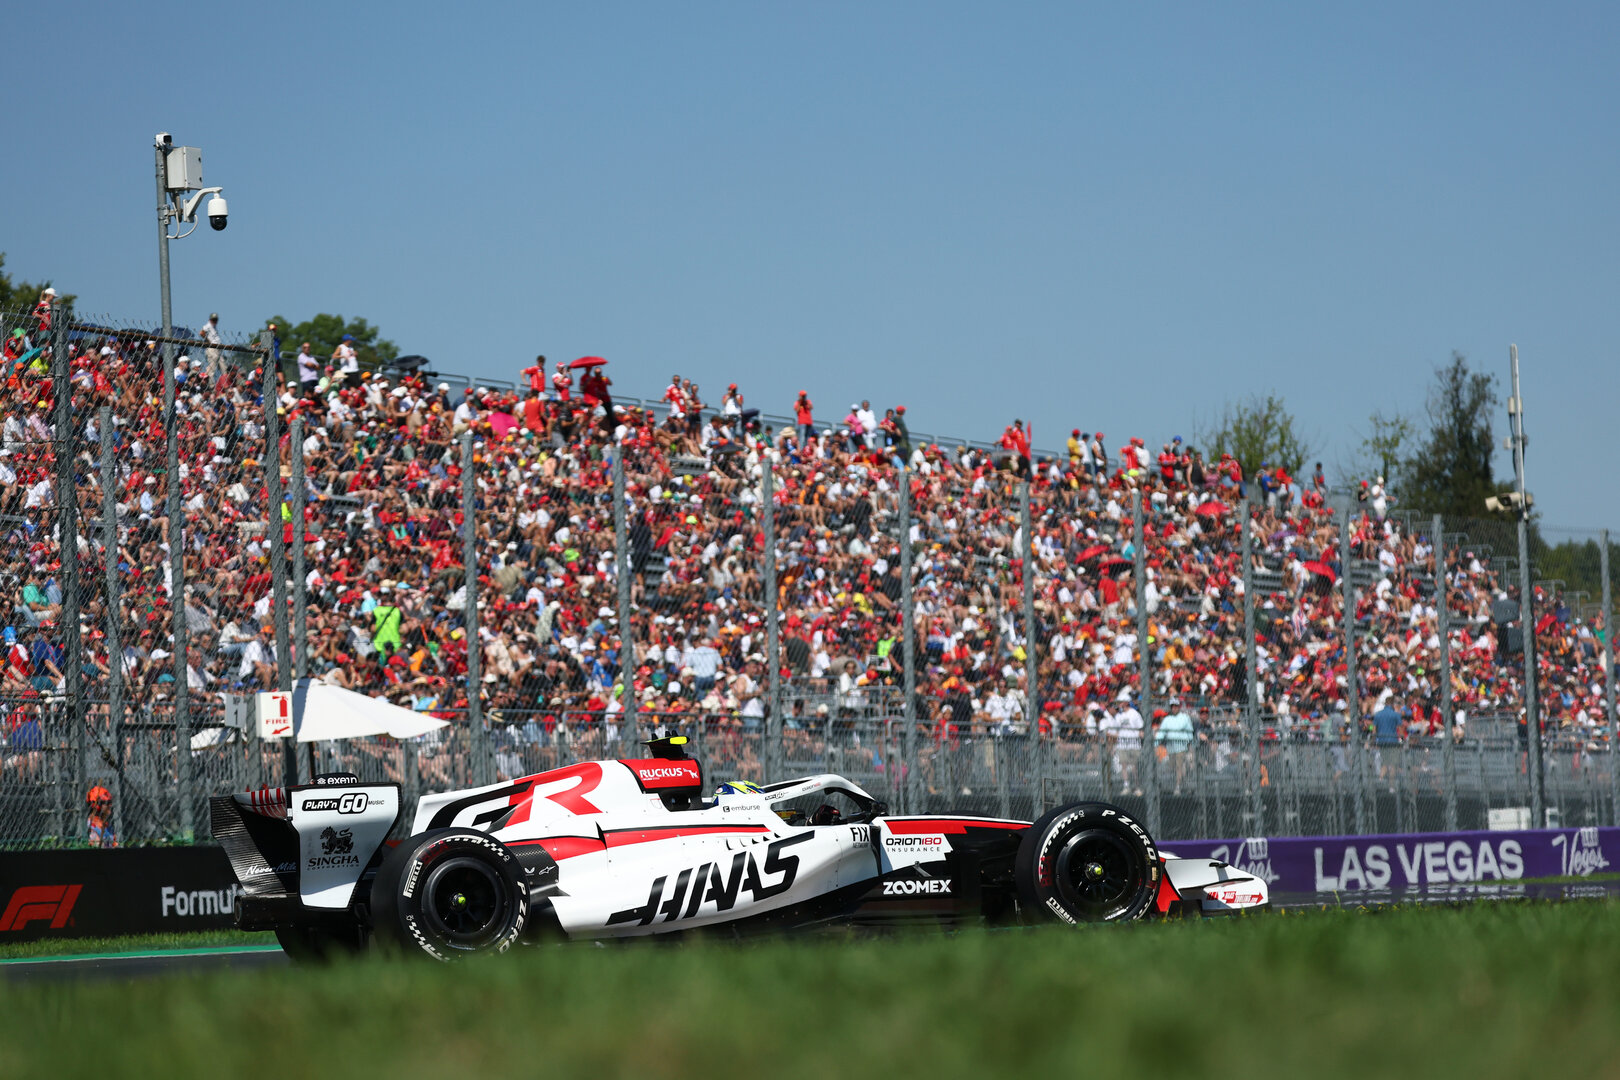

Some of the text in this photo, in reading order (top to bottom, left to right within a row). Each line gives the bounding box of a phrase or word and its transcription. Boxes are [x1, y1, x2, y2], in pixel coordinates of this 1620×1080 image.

[233, 708, 239, 726] 1
[639, 767, 683, 778] RUCKUS
[305, 800, 338, 810] PLAY'n
[338, 794, 368, 813] GO
[850, 826, 869, 842] FIX
[885, 837, 942, 846] ORION180
[1101, 809, 1157, 861] P ZERO
[308, 855, 360, 867] SINGHA
[1314, 839, 1524, 892] LAS VEGAS
[1552, 831, 1610, 877] Vegas
[402, 859, 423, 898] PIRELLI
[604, 830, 815, 926] HAAS
[883, 879, 952, 895] ZOOMEX
[0, 884, 83, 931] F1
[498, 881, 527, 954] P ZERO
